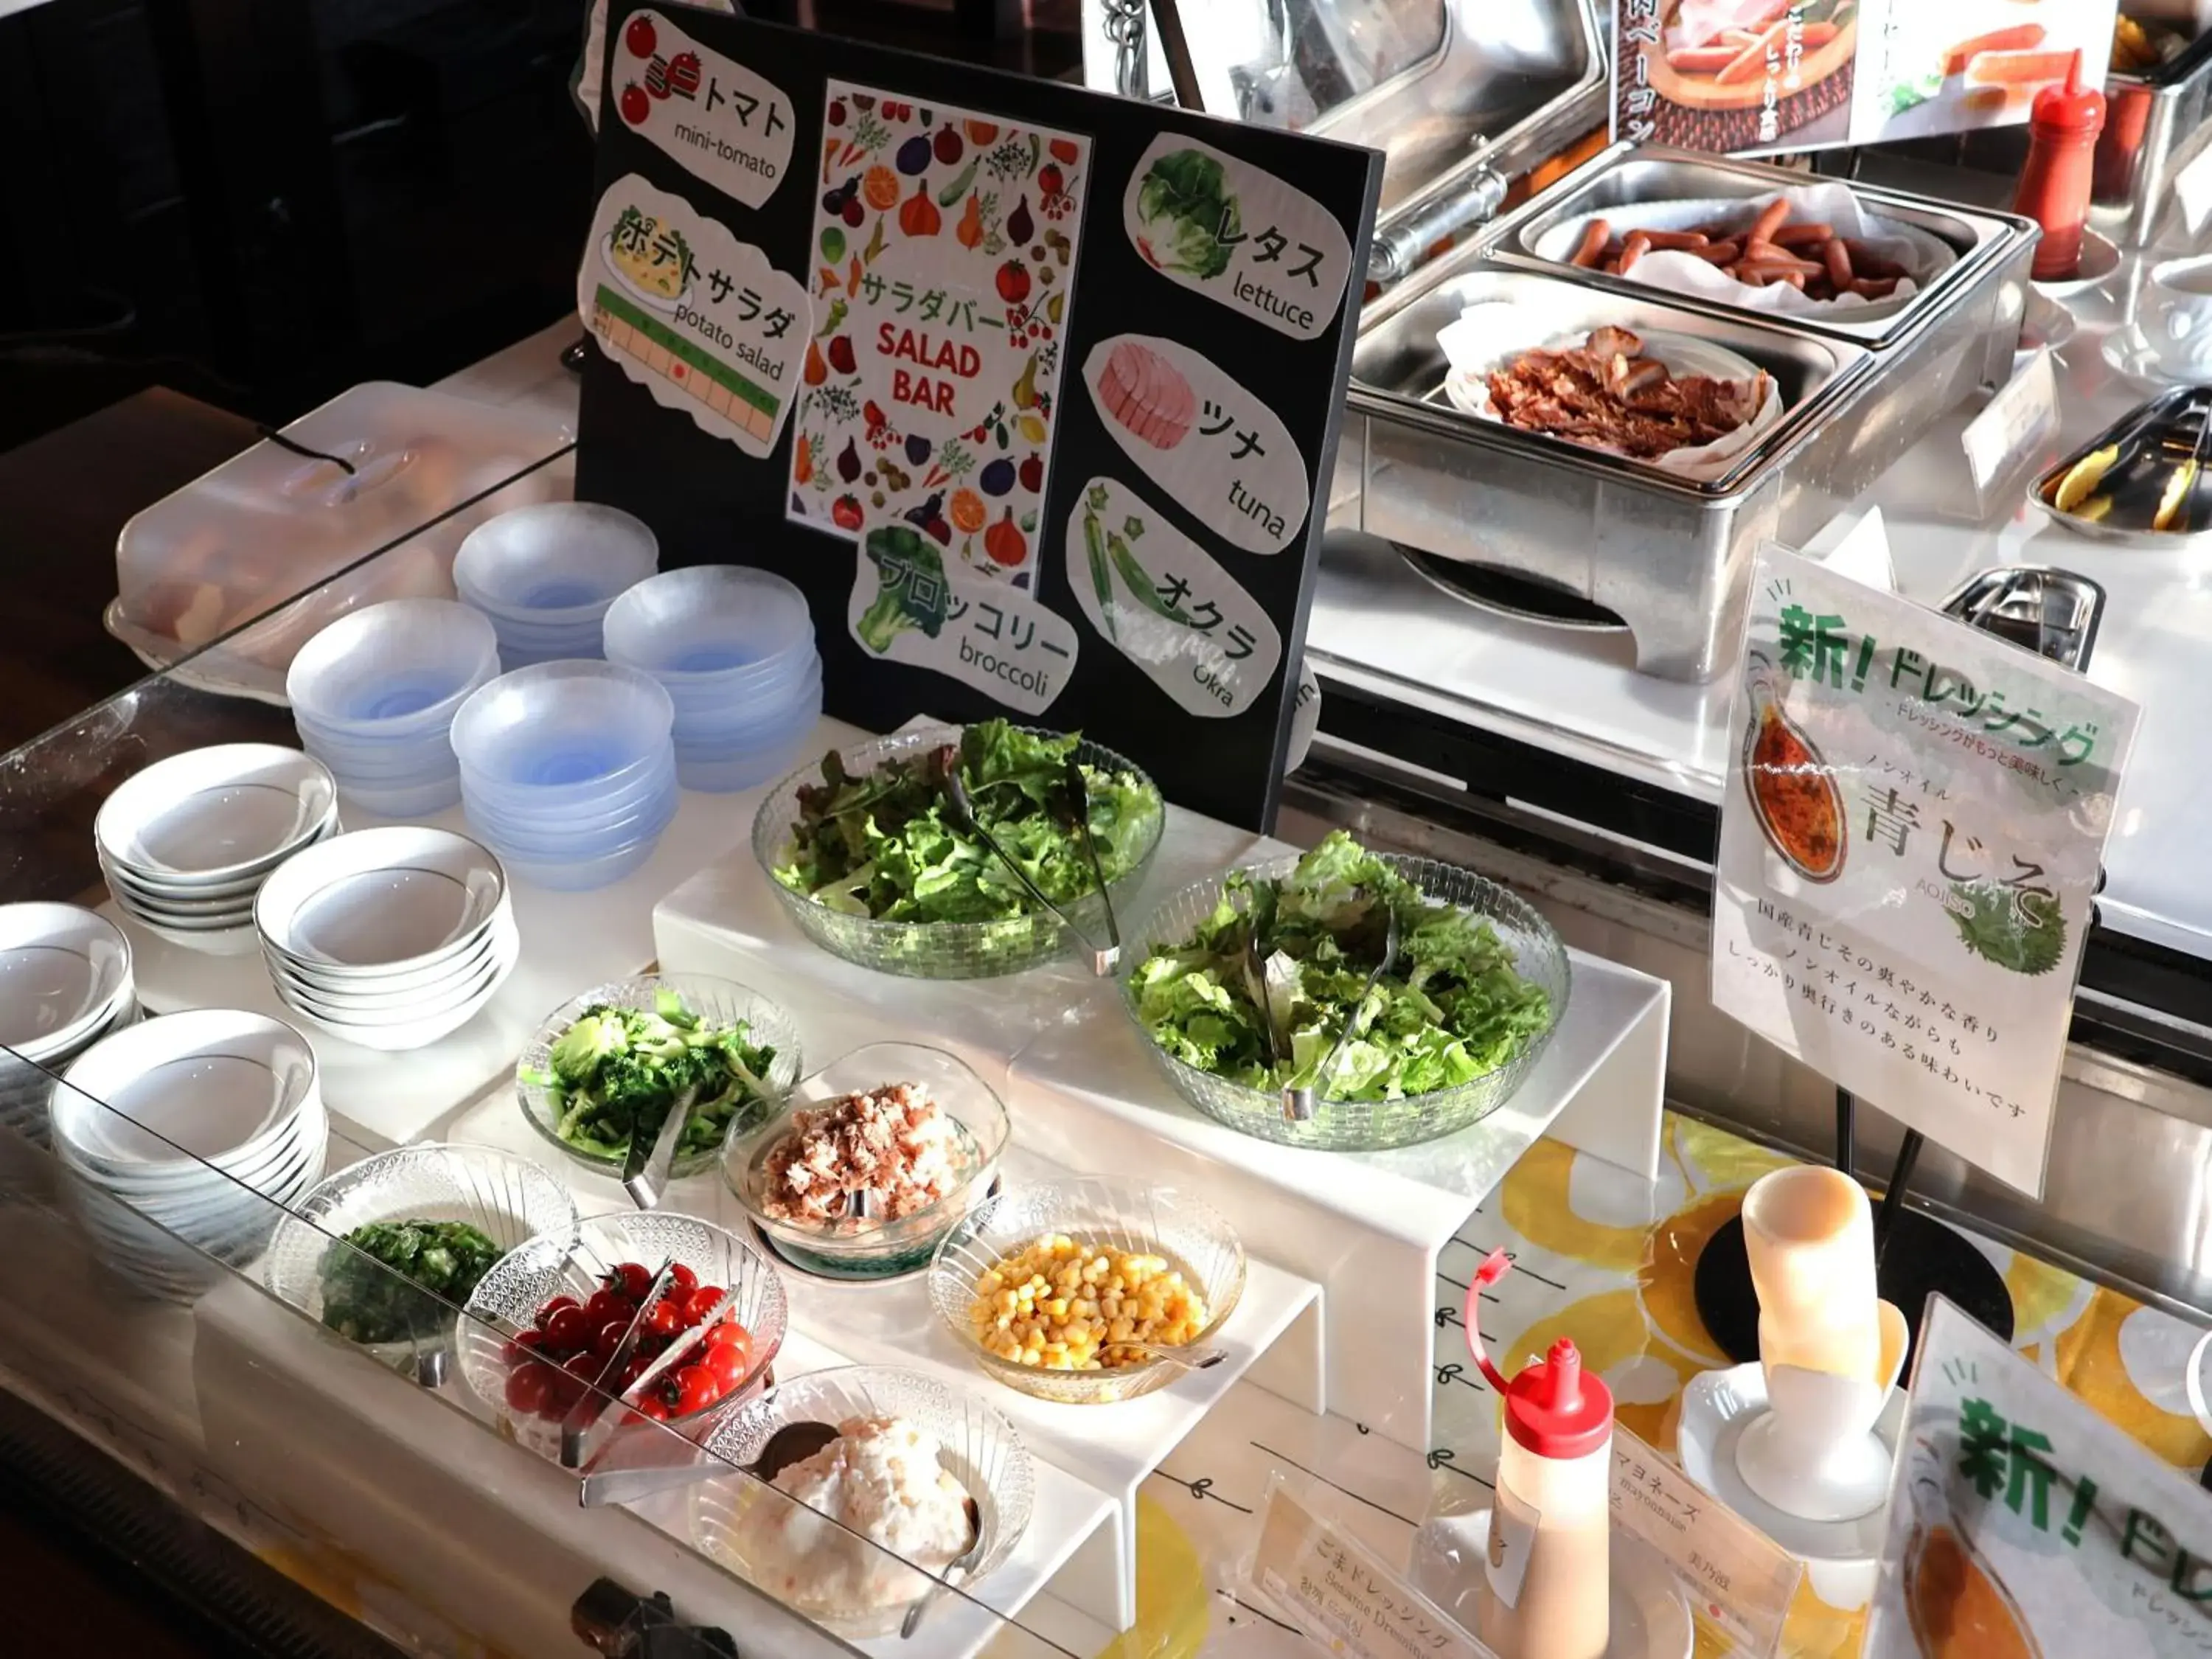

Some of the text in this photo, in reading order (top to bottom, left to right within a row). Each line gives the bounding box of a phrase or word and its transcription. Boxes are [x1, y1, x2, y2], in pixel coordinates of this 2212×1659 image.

[645, 52, 785, 138] ミニトマト
[674, 122, 776, 178] mini-tomato
[621, 218, 796, 341] ポテトサラダ
[1216, 207, 1324, 288] レタス
[860, 272, 1005, 332] サラダバー
[1234, 272, 1314, 330] lettuce
[673, 304, 733, 349] potato
[736, 341, 785, 381] salad
[876, 323, 981, 378] SALAD
[892, 369, 956, 417] BAR
[1199, 400, 1265, 459] ツナ
[1228, 479, 1285, 540] tuna
[880, 556, 1068, 658] ブロッコリー
[1155, 572, 1257, 659] オクラ
[959, 636, 1048, 697] broccoli
[1865, 755, 1950, 800] ノンオイル
[1860, 788, 2053, 928] 青じそ
[1758, 897, 1997, 1043] 国産青じその爽やかな香り
[1786, 949, 1961, 1056] ノンオイルながらも
[1729, 939, 2025, 1118] しっかり奥行きのある味わいです
[1616, 1450, 1701, 1523] マヨネーズ
[1316, 1538, 1450, 1649] ごまドレッシング
[1325, 1570, 1371, 1616] Sesame
